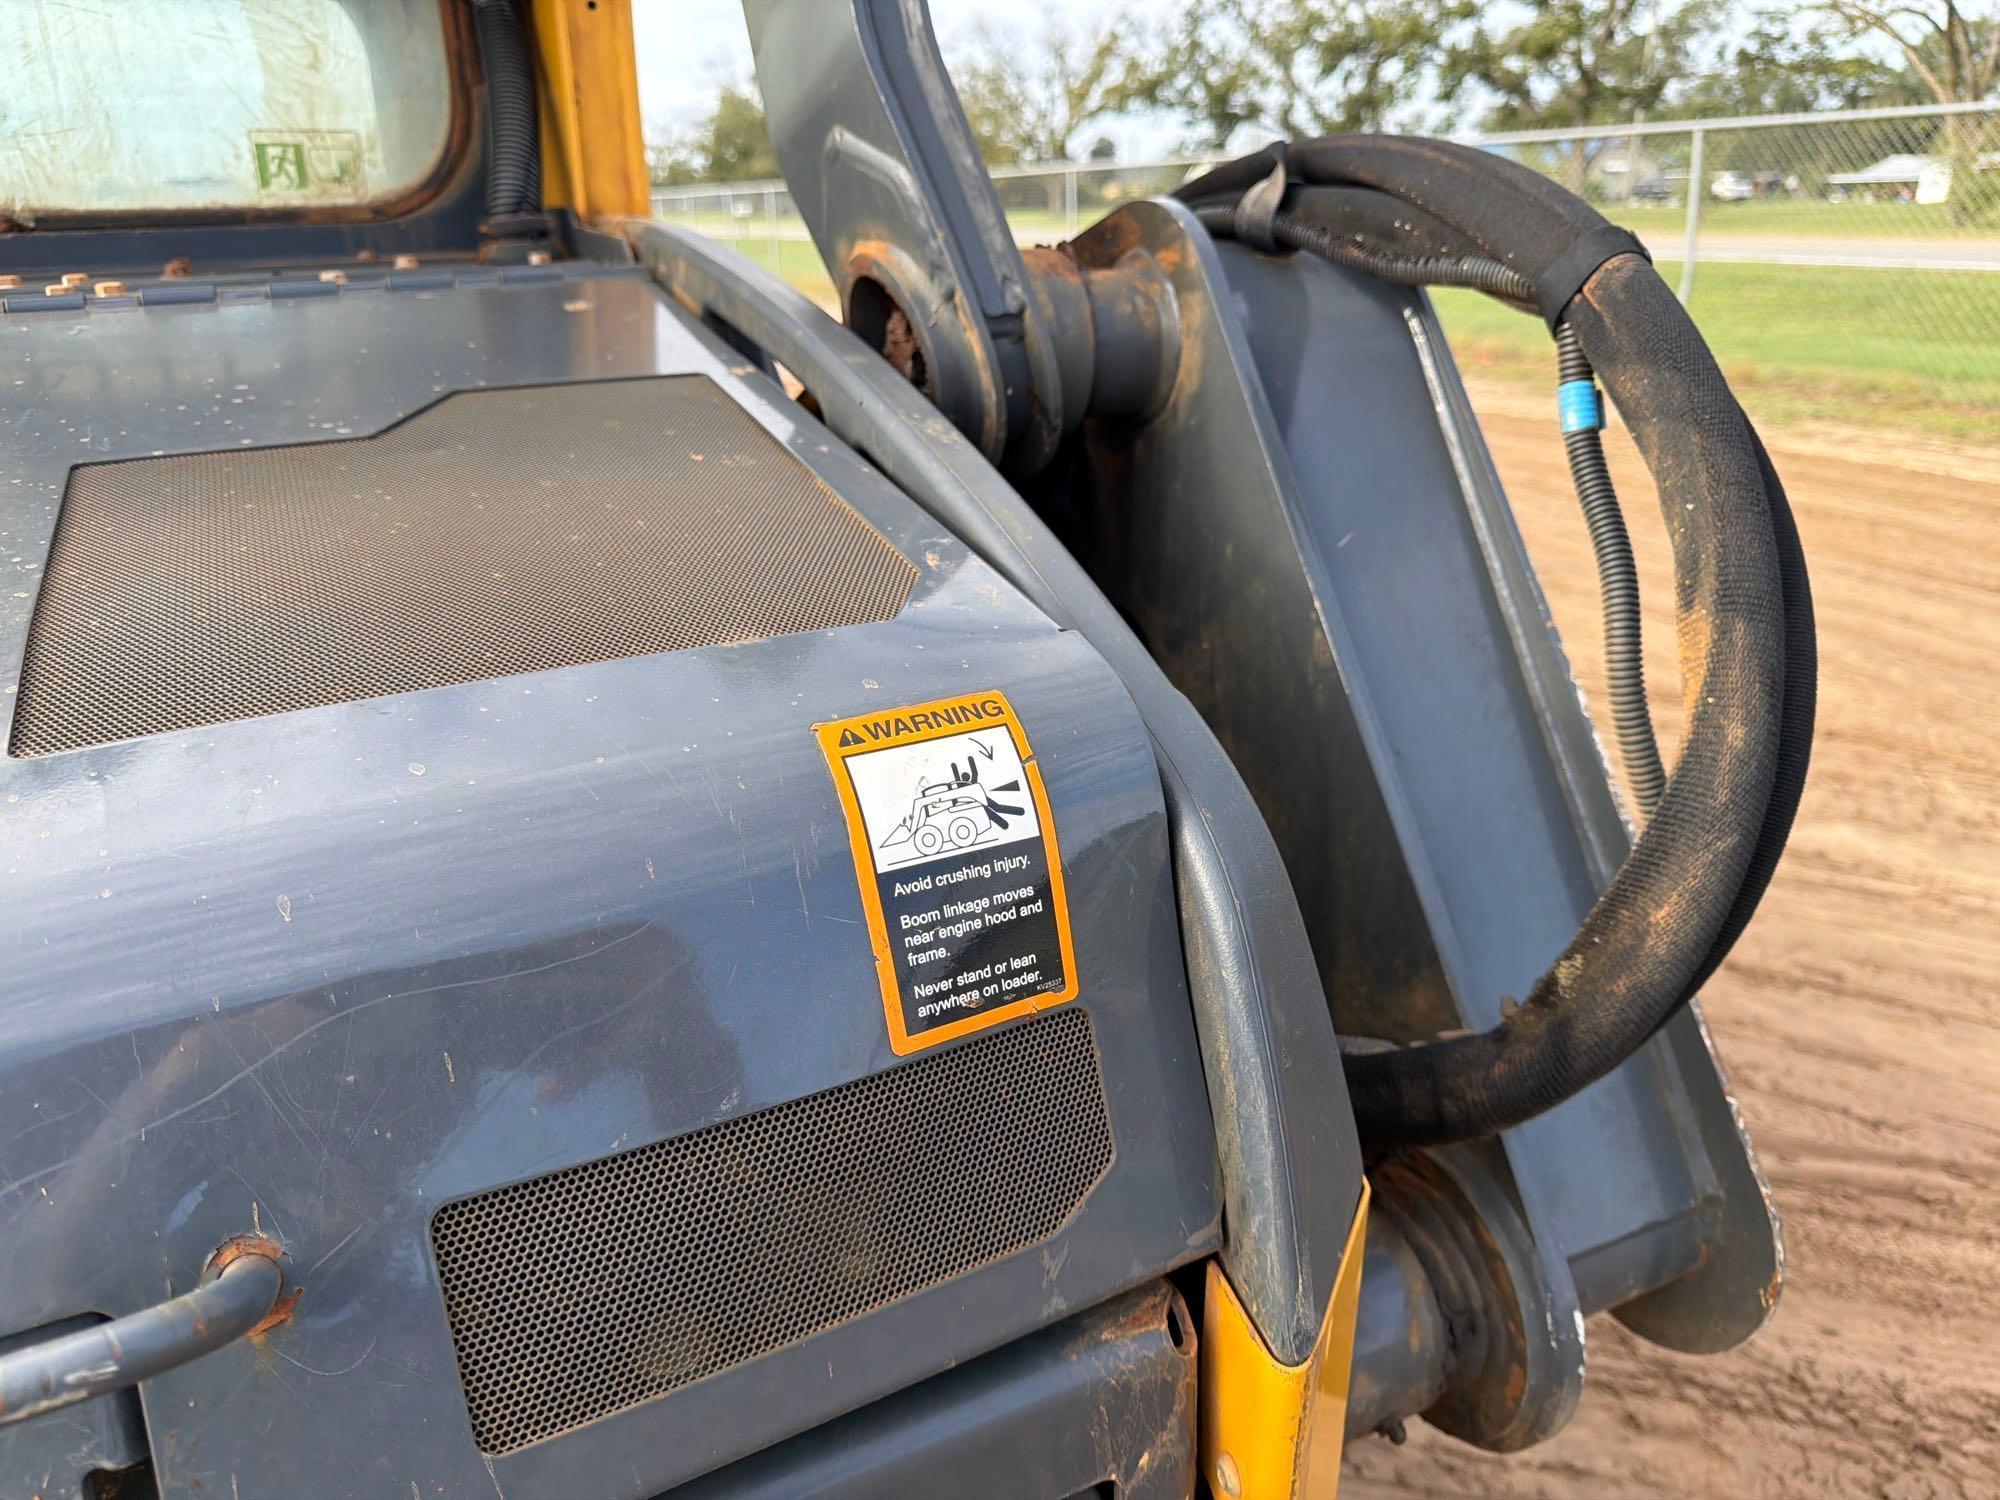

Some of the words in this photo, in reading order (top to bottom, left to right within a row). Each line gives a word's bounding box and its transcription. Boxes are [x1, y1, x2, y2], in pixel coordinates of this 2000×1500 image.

[862, 700, 1005, 741] WARNING
[894, 874, 932, 897] Avoid
[936, 864, 991, 887] crushing
[994, 854, 1031, 873] injury.
[900, 909, 940, 929] Boom
[943, 897, 990, 918] linkage
[993, 885, 1034, 905] moves
[904, 929, 936, 948] near
[938, 916, 981, 940] engine
[984, 905, 1016, 926] hood
[1019, 900, 1043, 916] and
[908, 947, 951, 967] frame.
[914, 979, 954, 999] Never
[957, 968, 991, 988] stand
[994, 961, 1008, 976] or
[1010, 953, 1037, 971] lean
[917, 990, 980, 1017] anywhere
[982, 984, 999, 999] on
[1001, 970, 1043, 992] loader.
